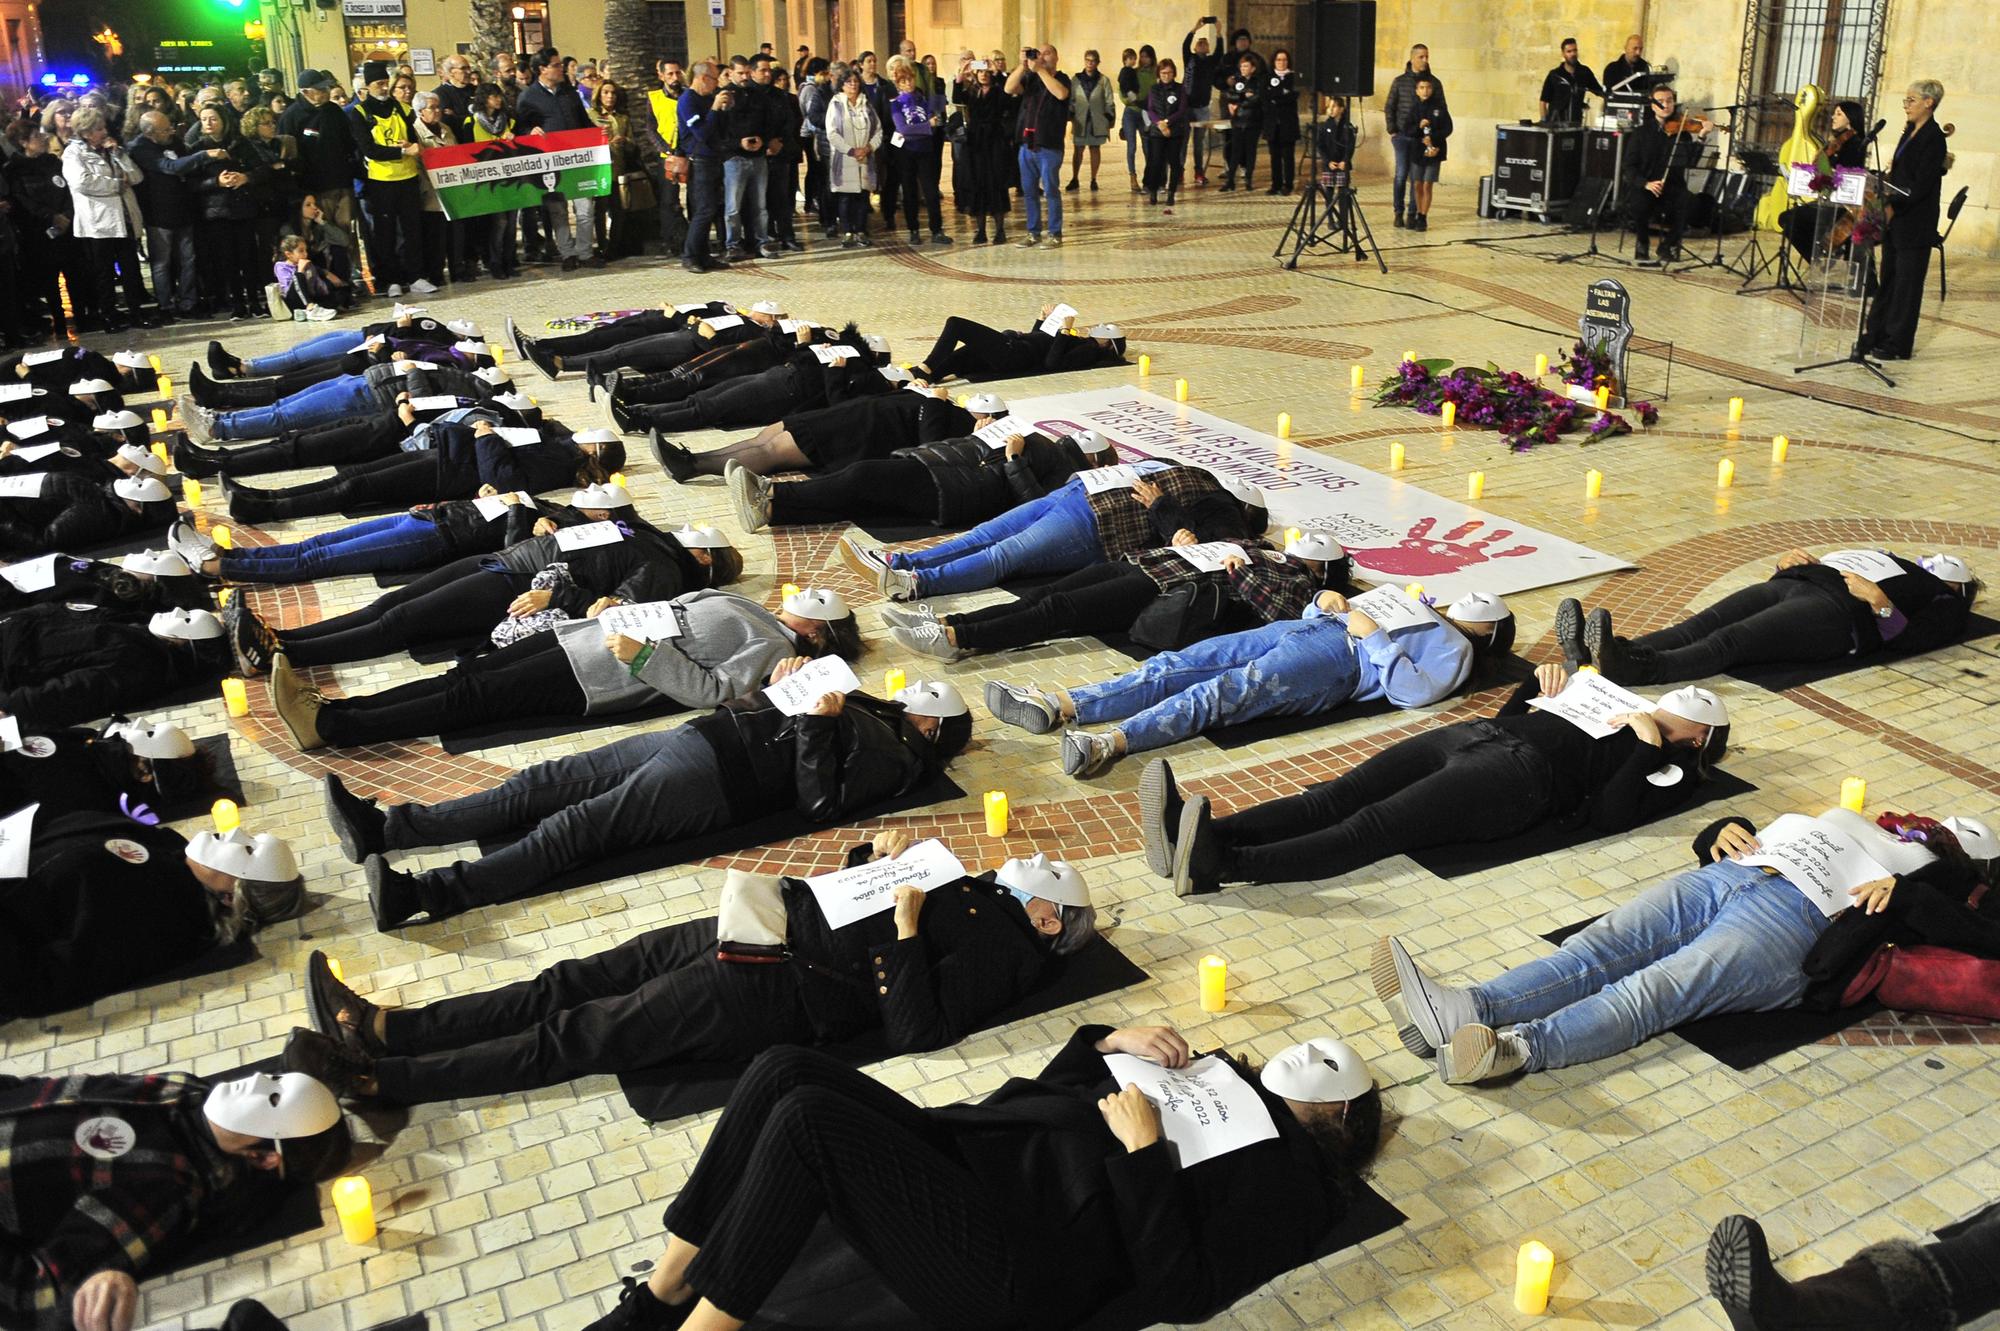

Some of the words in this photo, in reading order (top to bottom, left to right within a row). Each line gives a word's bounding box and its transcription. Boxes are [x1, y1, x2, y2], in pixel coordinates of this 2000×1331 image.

[436, 171, 458, 185] Irán:
[459, 166, 500, 183] ¡Mujeres,
[501, 158, 542, 177] igualdad
[544, 157, 551, 169] y
[552, 150, 594, 167] libertad!
[1594, 288, 1616, 299] FALTAN
[1598, 298, 1609, 307] LAS
[1081, 410, 1133, 426] NOS
[1165, 443, 1303, 491] ASESINANDO
[1108, 400, 1214, 435] DISCULPEN
[1195, 433, 1249, 448] LAS
[1230, 447, 1360, 493] MOLESTIAS,
[893, 868, 931, 886] Florina
[1808, 856, 1831, 878] 2022
[851, 889, 876, 901] años
[878, 883, 892, 895] 26
[1191, 1099, 1211, 1127] 2022
[1213, 1100, 1229, 1123] años
